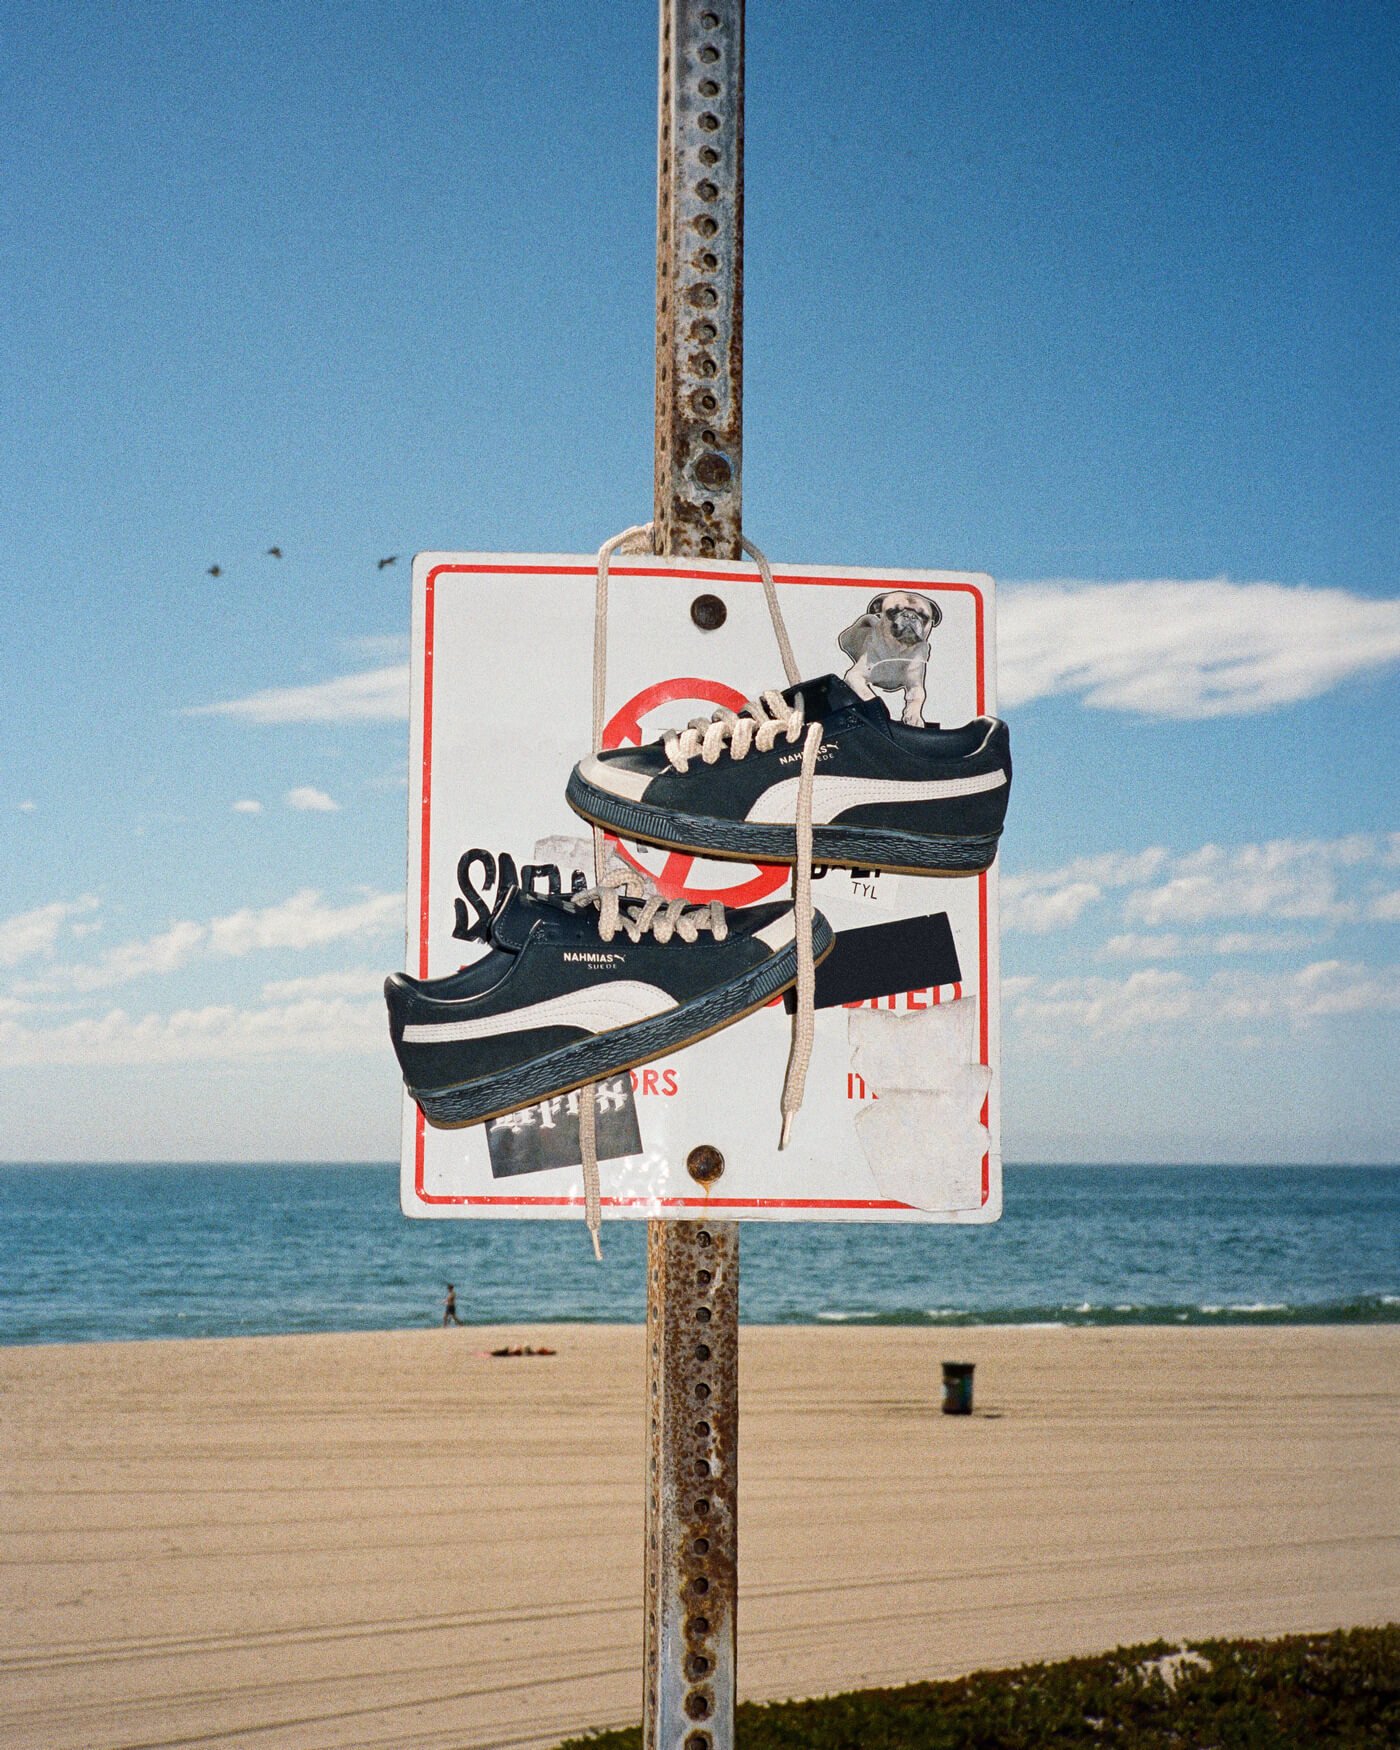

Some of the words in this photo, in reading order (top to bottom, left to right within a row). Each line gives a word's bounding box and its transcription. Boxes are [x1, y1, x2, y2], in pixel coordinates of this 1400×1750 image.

[779, 745, 828, 765] NAHS
[851, 881, 878, 900] TYL
[563, 952, 614, 963] NAHMIAS
